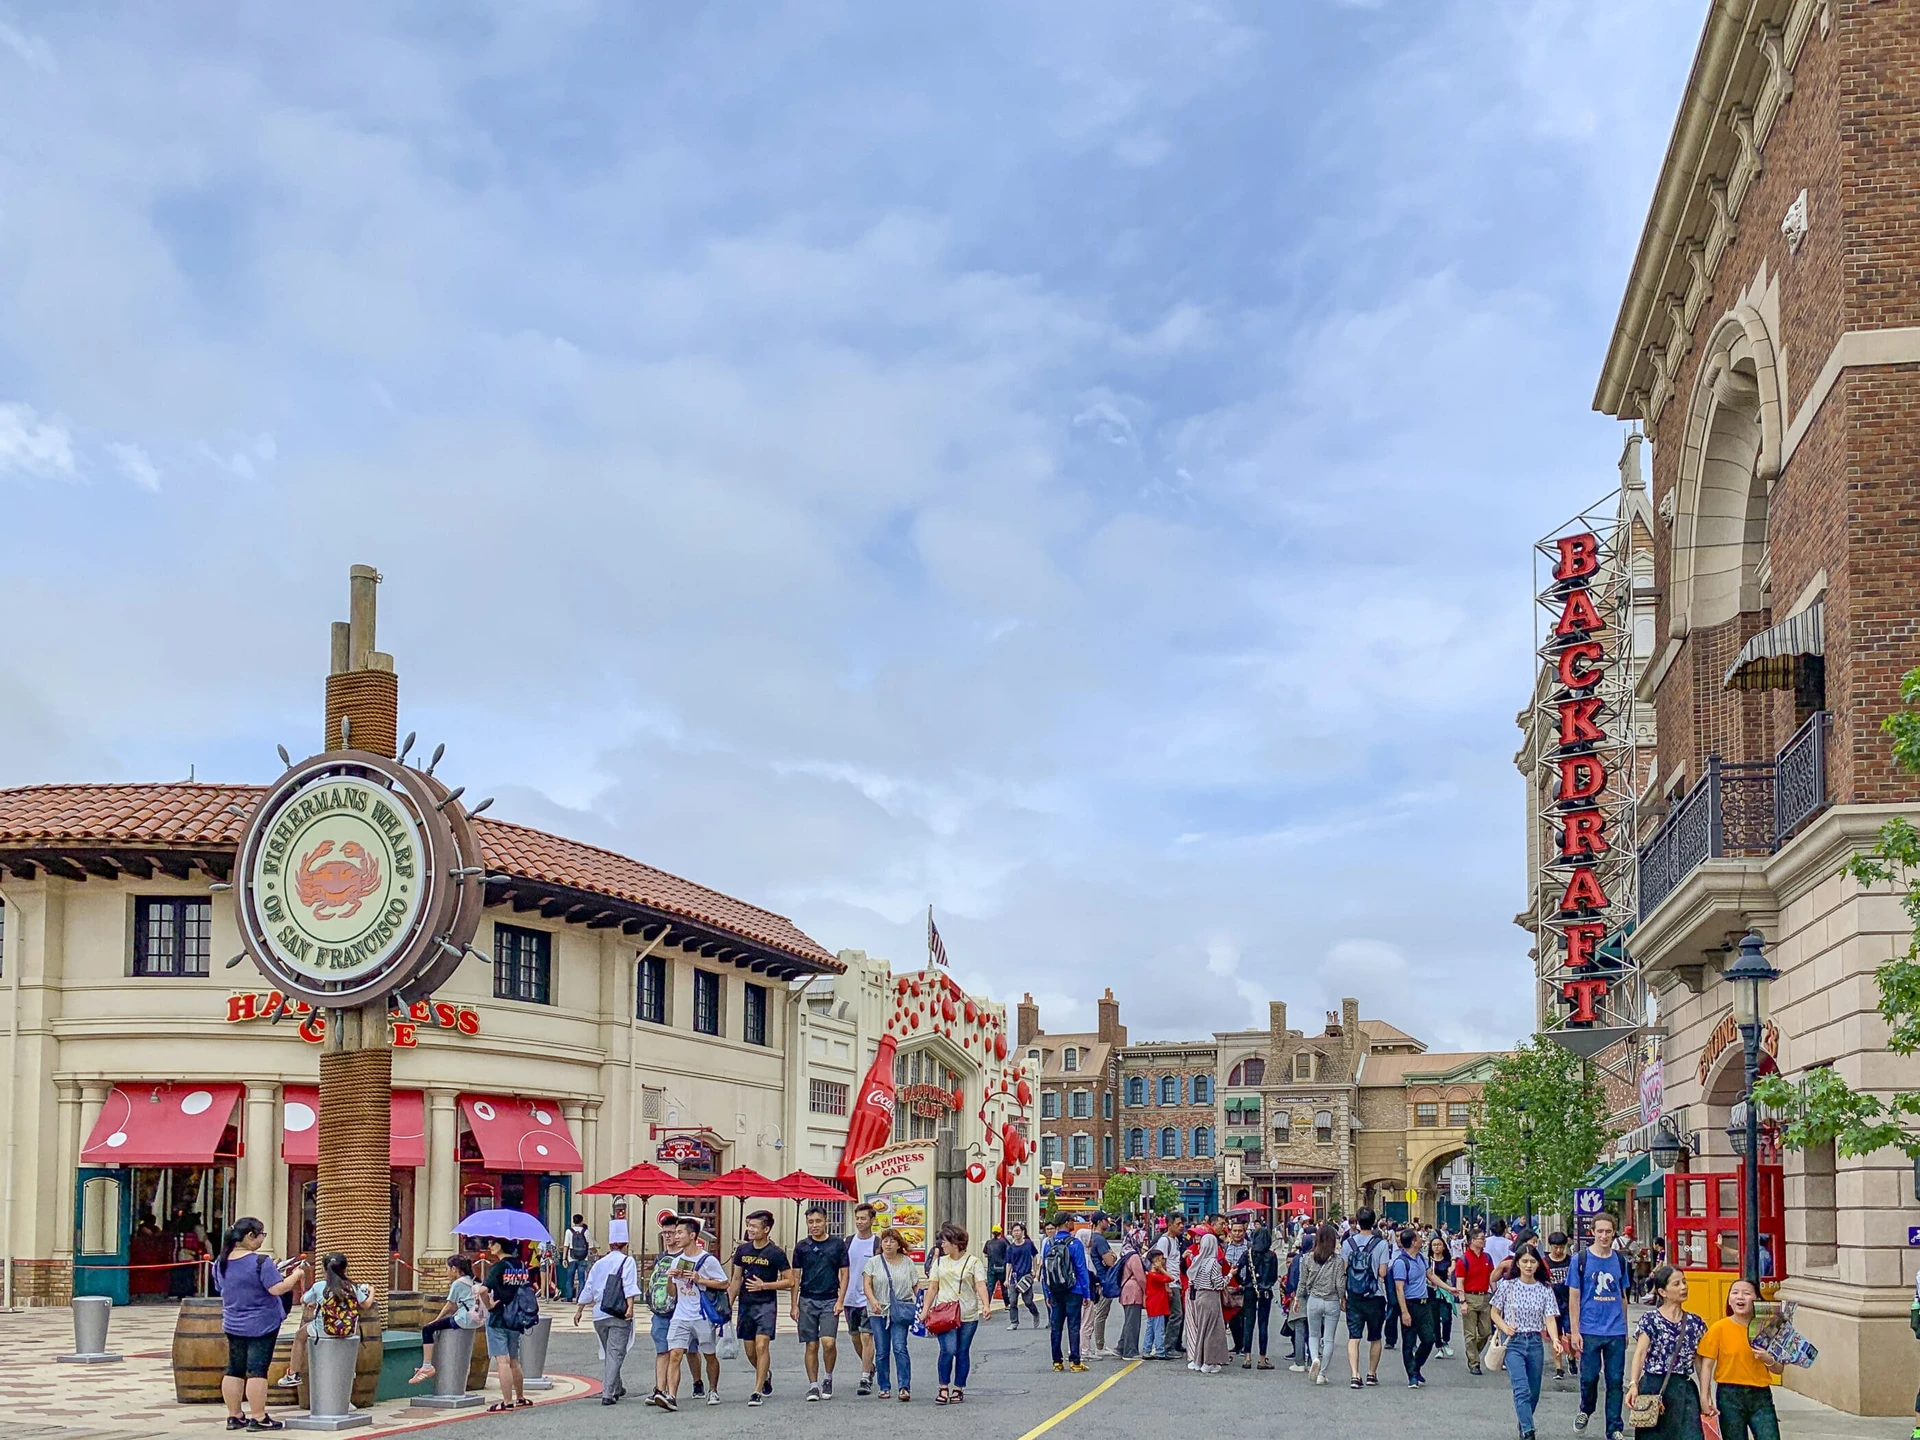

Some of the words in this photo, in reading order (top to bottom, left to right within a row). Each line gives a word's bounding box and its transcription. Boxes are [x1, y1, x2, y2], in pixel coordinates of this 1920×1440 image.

[1557, 534, 1608, 1023] BACKDRAFT
[263, 787, 369, 877] FISHERMANS
[370, 799, 415, 880] WHARF
[263, 894, 286, 924] OF
[277, 925, 314, 963] SAN
[313, 898, 408, 970] FRANCISCO
[225, 989, 480, 1036] HAESS
[297, 1017, 418, 1048] CE
[1699, 1013, 1738, 1087] ENGINE
[902, 1083, 957, 1112] HAPPINESS
[917, 1100, 944, 1119] CAFE
[865, 1153, 925, 1176] HAPPINESS
[882, 1163, 911, 1177] CAFE
